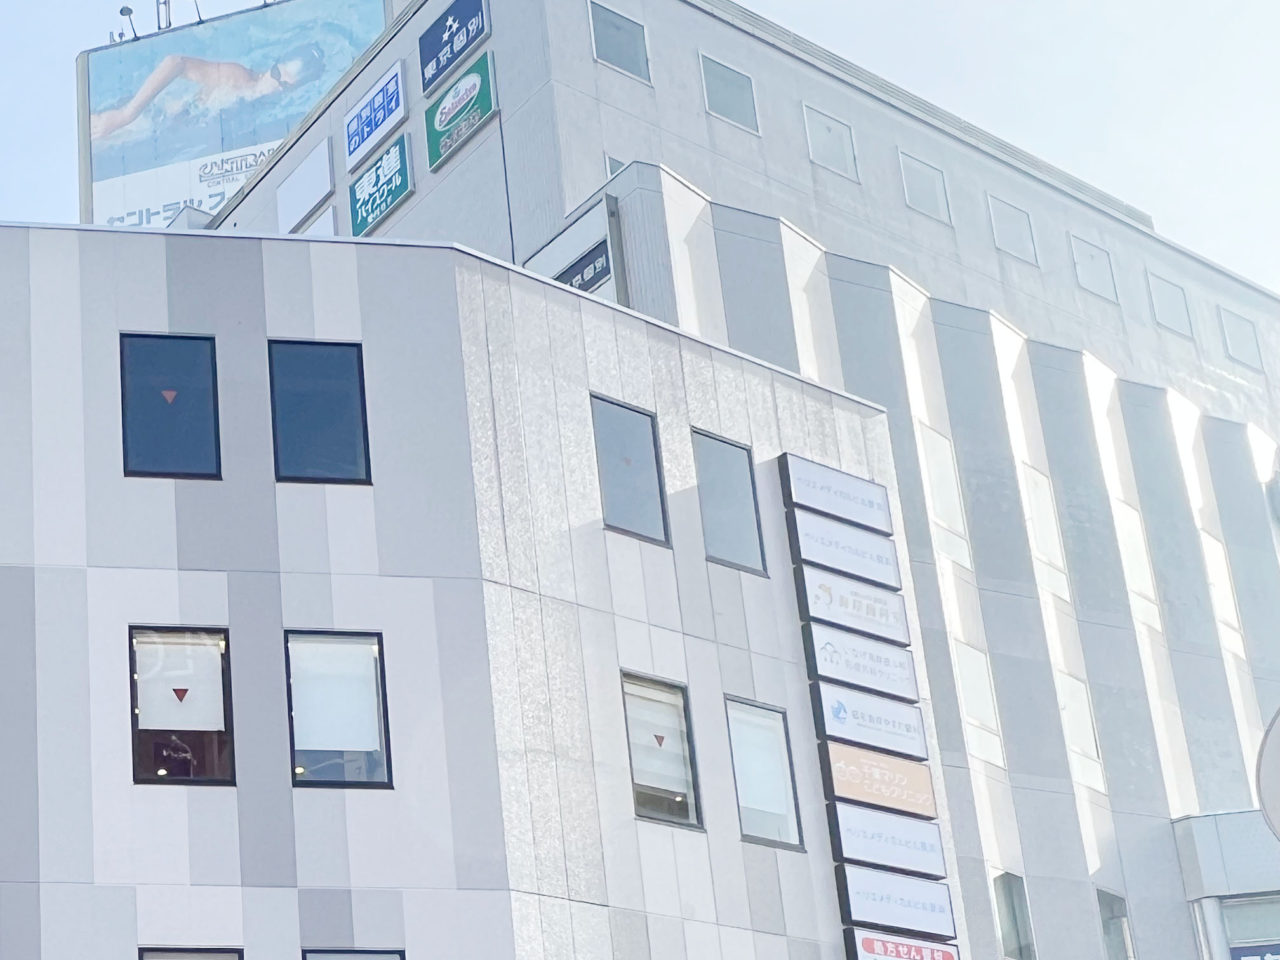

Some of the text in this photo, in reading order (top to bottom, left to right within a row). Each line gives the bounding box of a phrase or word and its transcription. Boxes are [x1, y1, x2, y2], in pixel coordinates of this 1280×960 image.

[424, 11, 483, 83] 東京個別
[354, 144, 401, 201] 東進
[567, 254, 606, 288] 京個別
